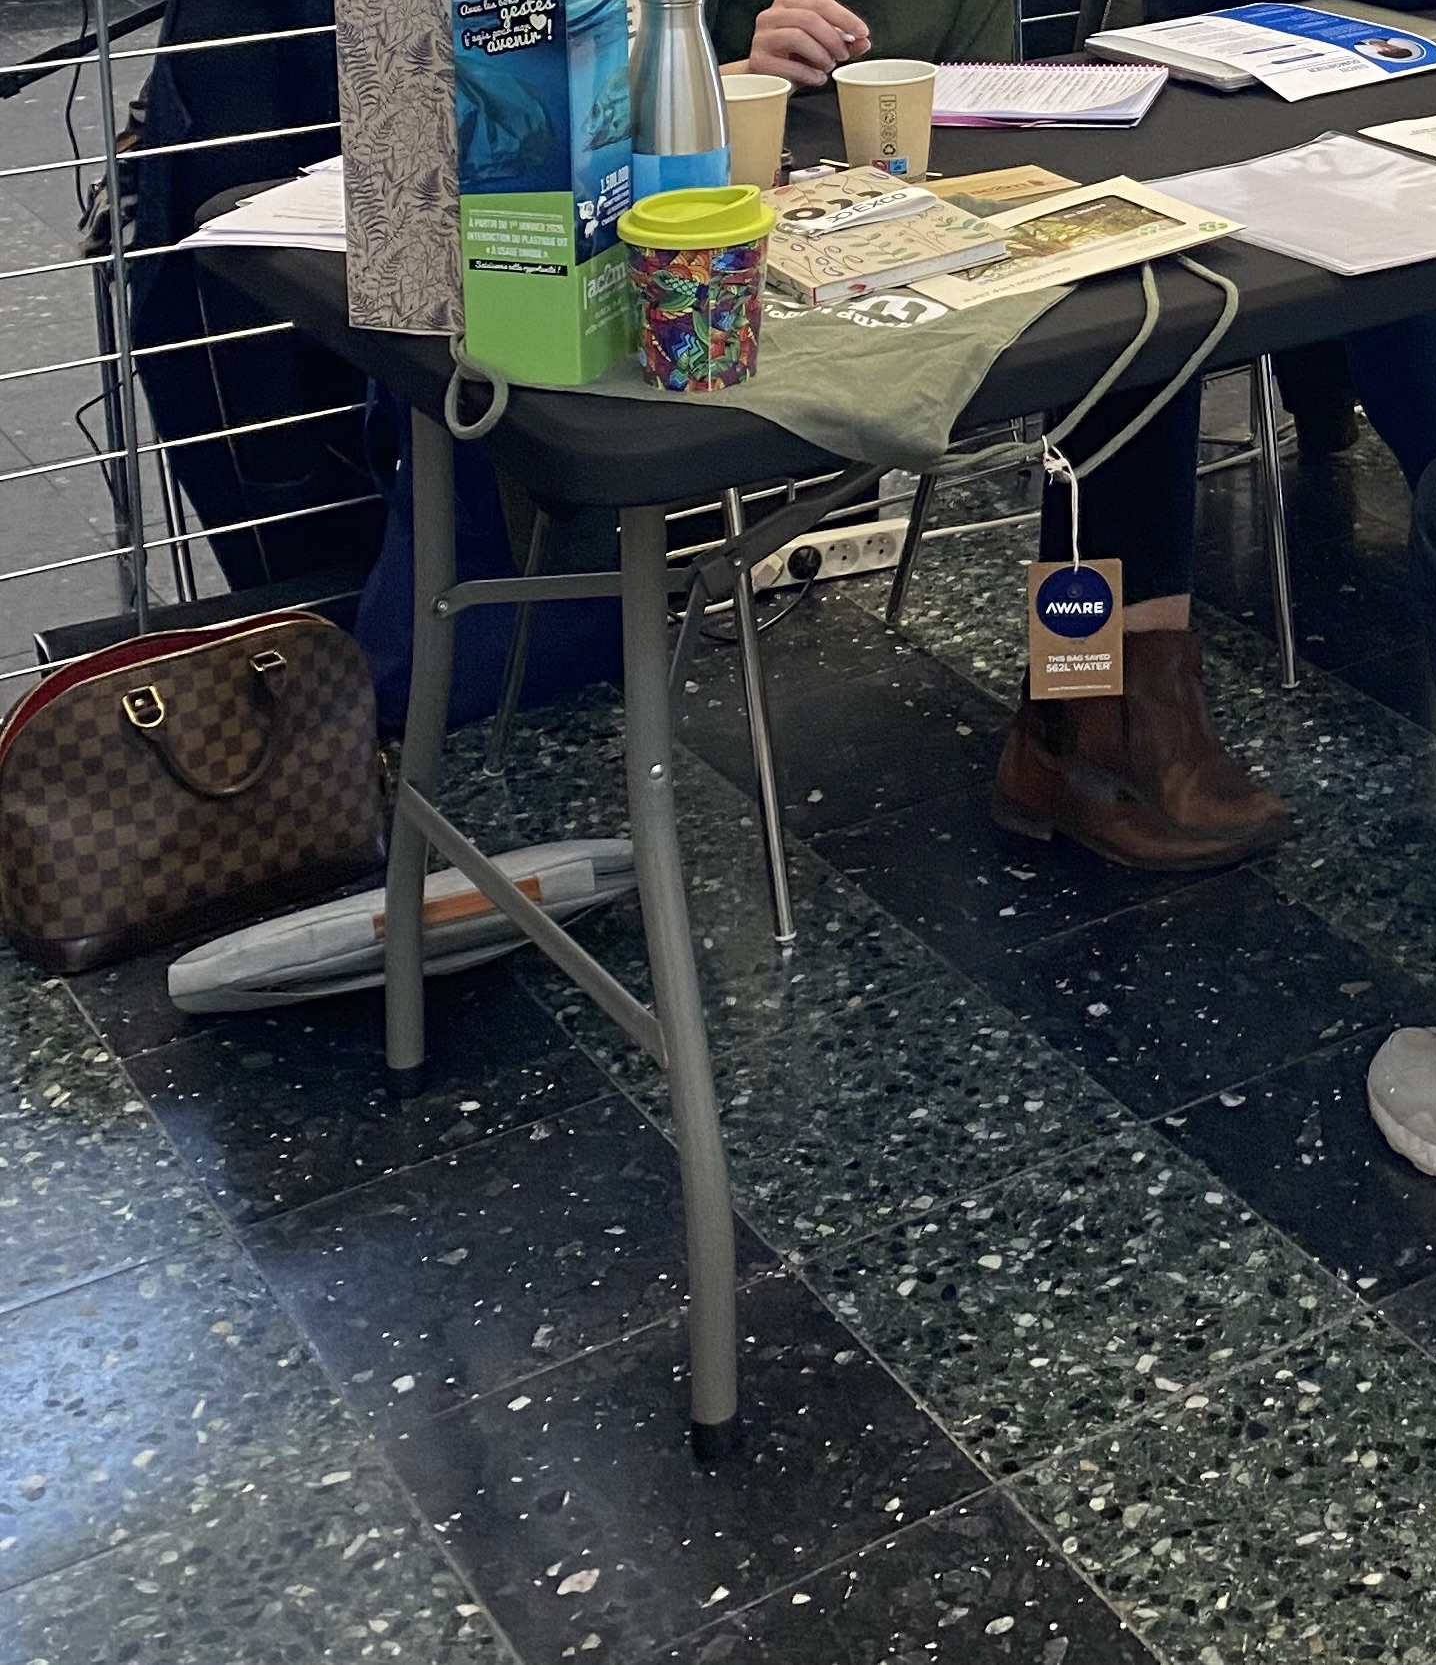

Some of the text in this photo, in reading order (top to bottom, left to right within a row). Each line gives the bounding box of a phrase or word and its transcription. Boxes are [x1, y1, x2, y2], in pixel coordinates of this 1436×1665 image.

[486, 31, 542, 53] avenir
[1045, 601, 1104, 614] AWARE
[1047, 653, 1111, 663] THIS BAG SAVED
